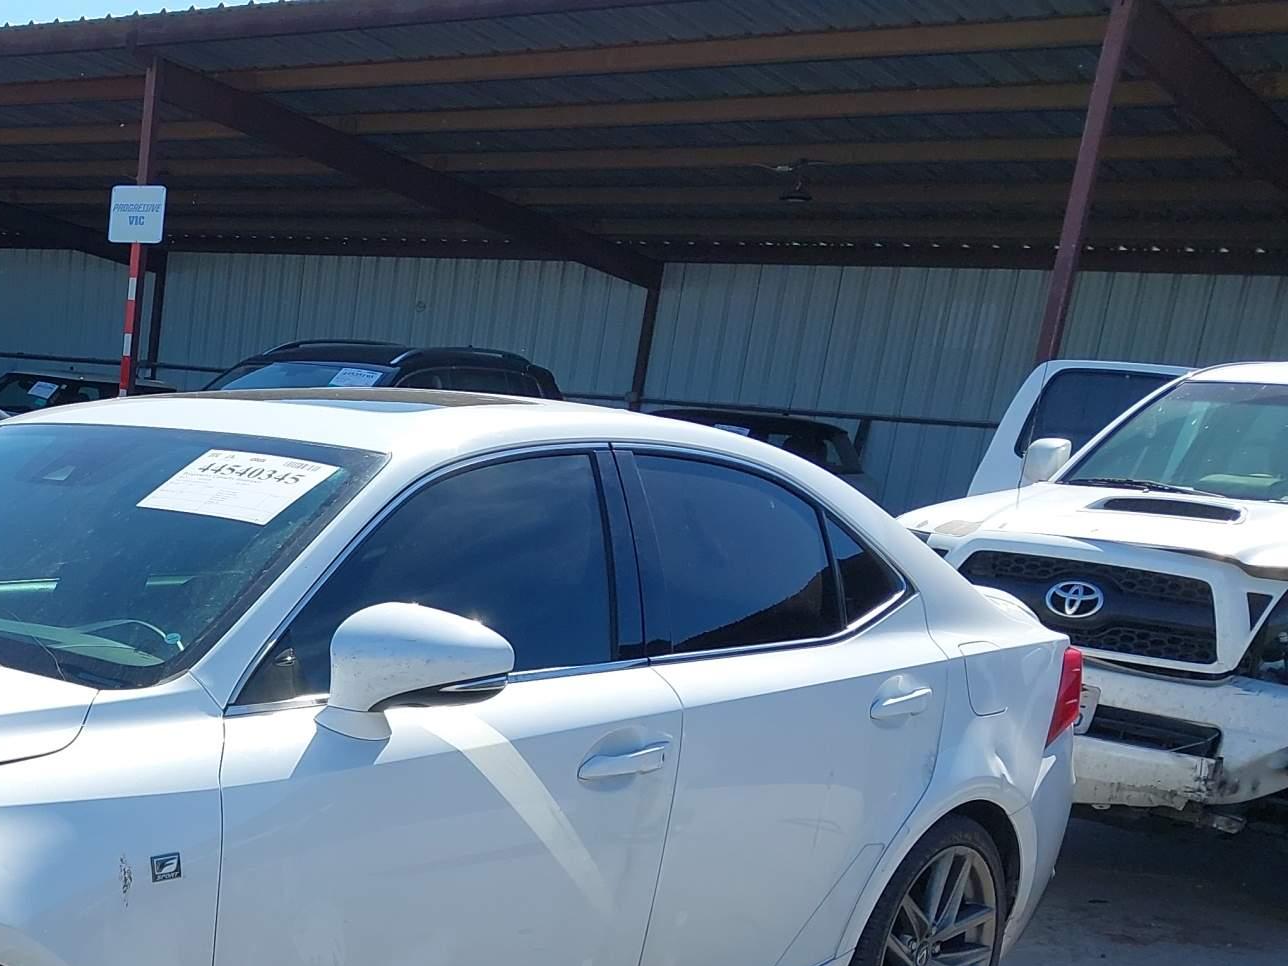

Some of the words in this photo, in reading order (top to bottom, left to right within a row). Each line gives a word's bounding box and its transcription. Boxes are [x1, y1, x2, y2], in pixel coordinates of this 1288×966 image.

[128, 215, 145, 226] VIC
[198, 462, 305, 485] 44540345
[156, 872, 179, 881] SPORT
